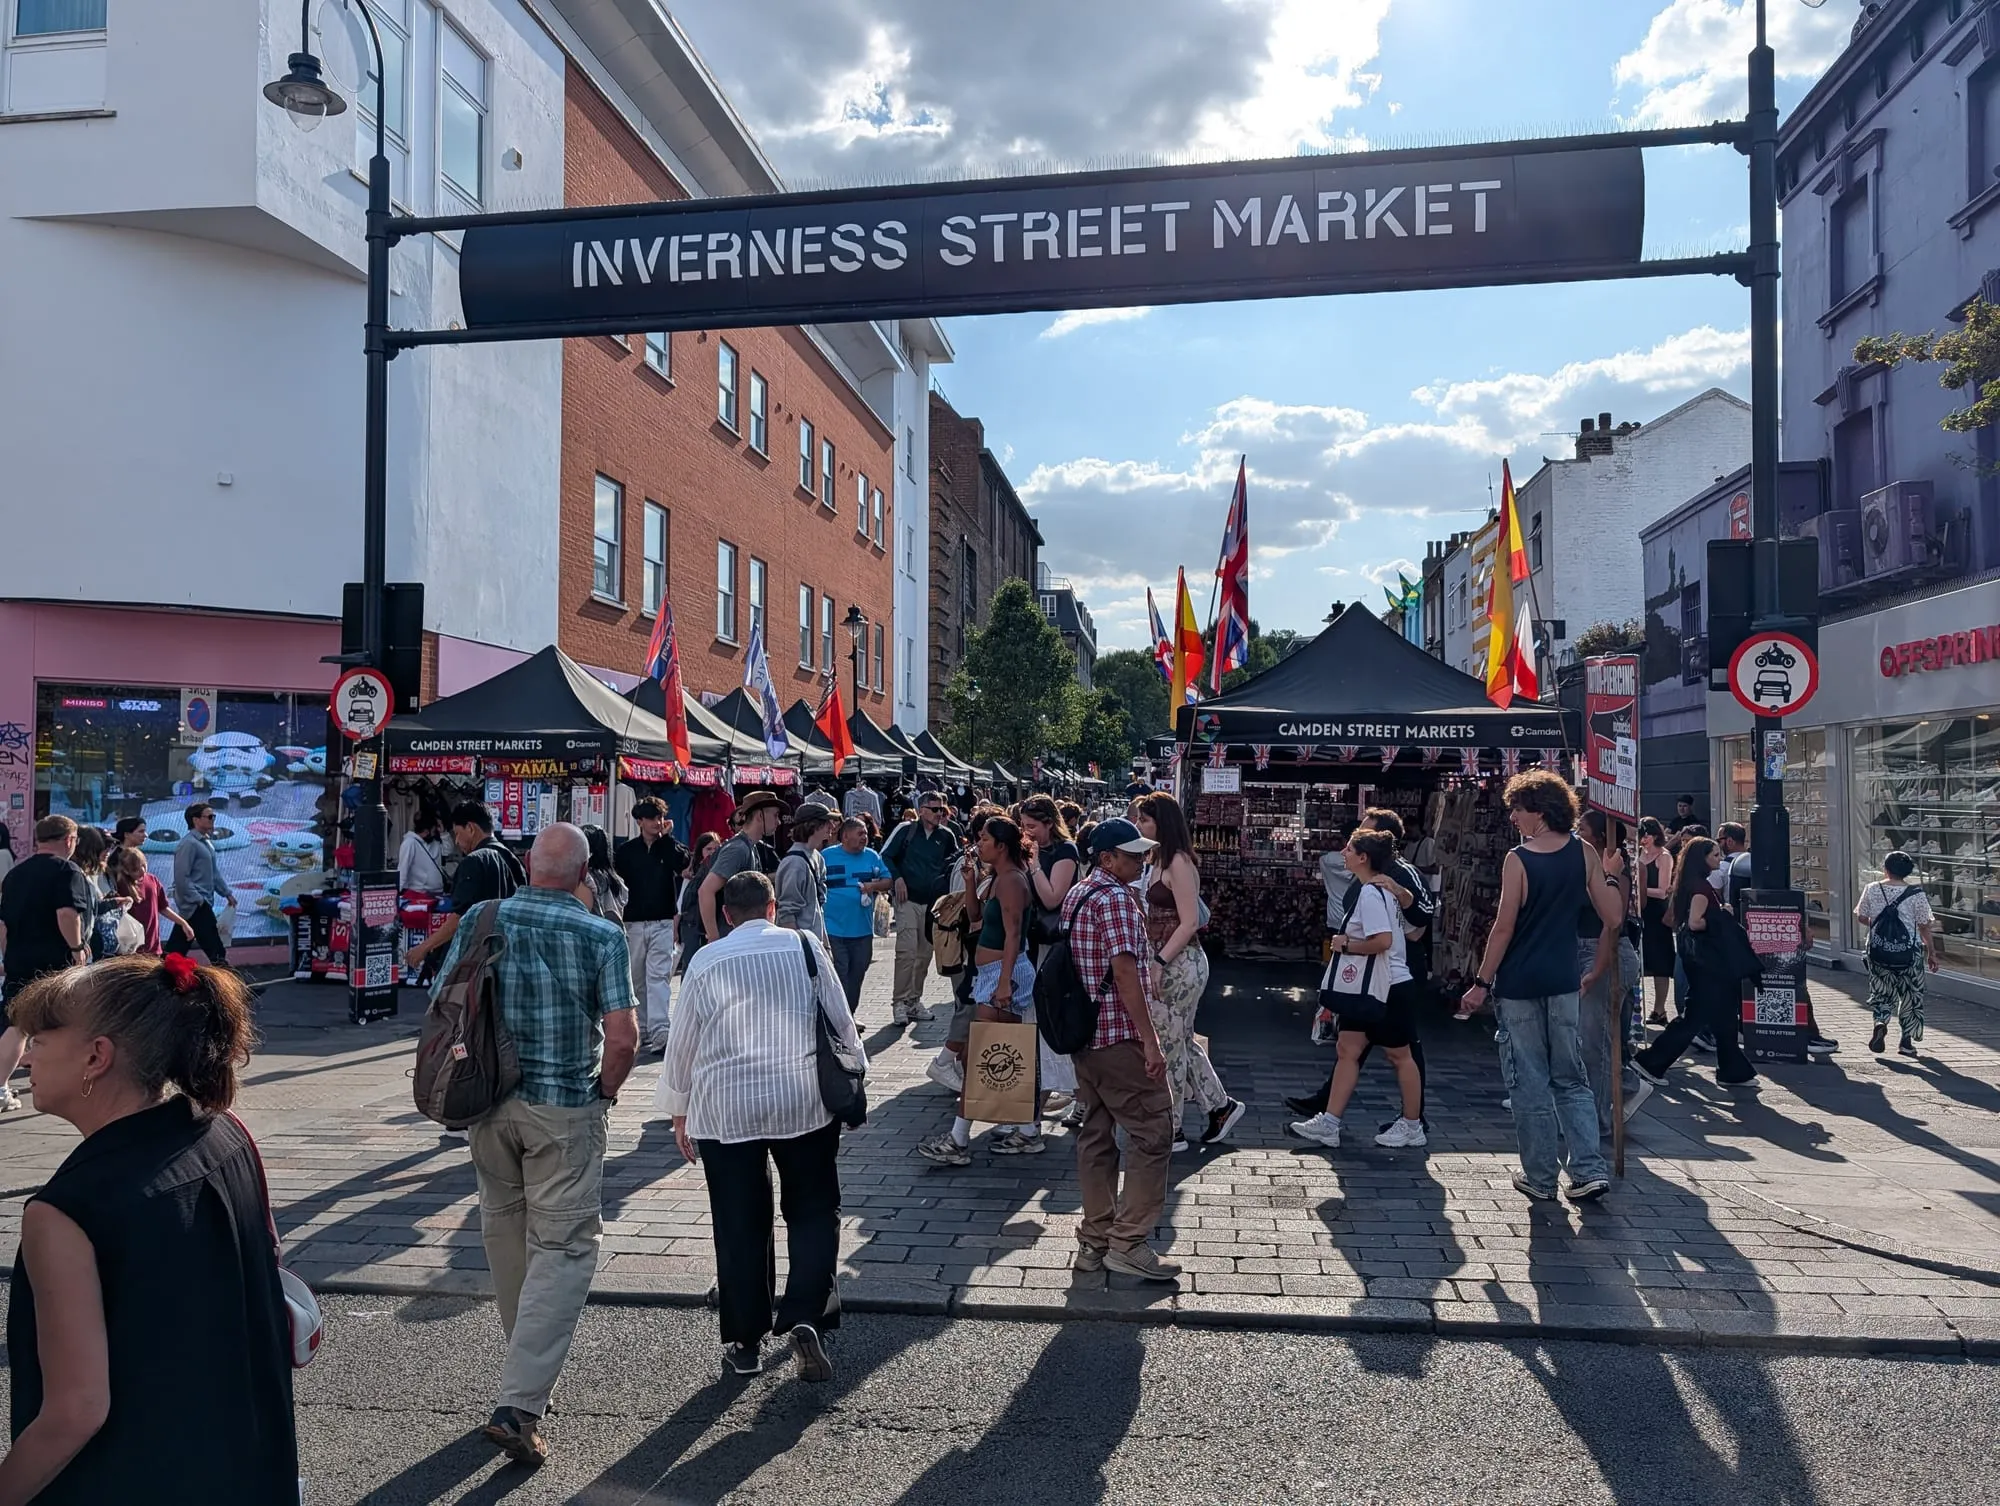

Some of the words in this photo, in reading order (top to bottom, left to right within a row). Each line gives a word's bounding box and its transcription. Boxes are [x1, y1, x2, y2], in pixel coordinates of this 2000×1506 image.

[573, 219, 908, 288] INVERNESS
[939, 201, 1191, 267] STREET
[1213, 179, 1502, 250] MARKET
[1279, 722, 1342, 737] CAMDEN
[1347, 723, 1401, 738] STREET
[1405, 725, 1476, 739] MARKETS
[1525, 727, 1562, 737] Camden
[410, 740, 453, 751] CAMDEN
[456, 740, 492, 750] STREET
[495, 739, 542, 750] MARKETS
[575, 740, 600, 748] Camden
[511, 762, 569, 774] YAMAL
[366, 900, 394, 908] DISCO
[364, 907, 395, 916] HOUSE
[1751, 923, 1797, 933] DISCO
[1749, 932, 1799, 942] HOUSE
[981, 1043, 1024, 1061] ROKIT
[983, 1075, 1017, 1088] LONDON
